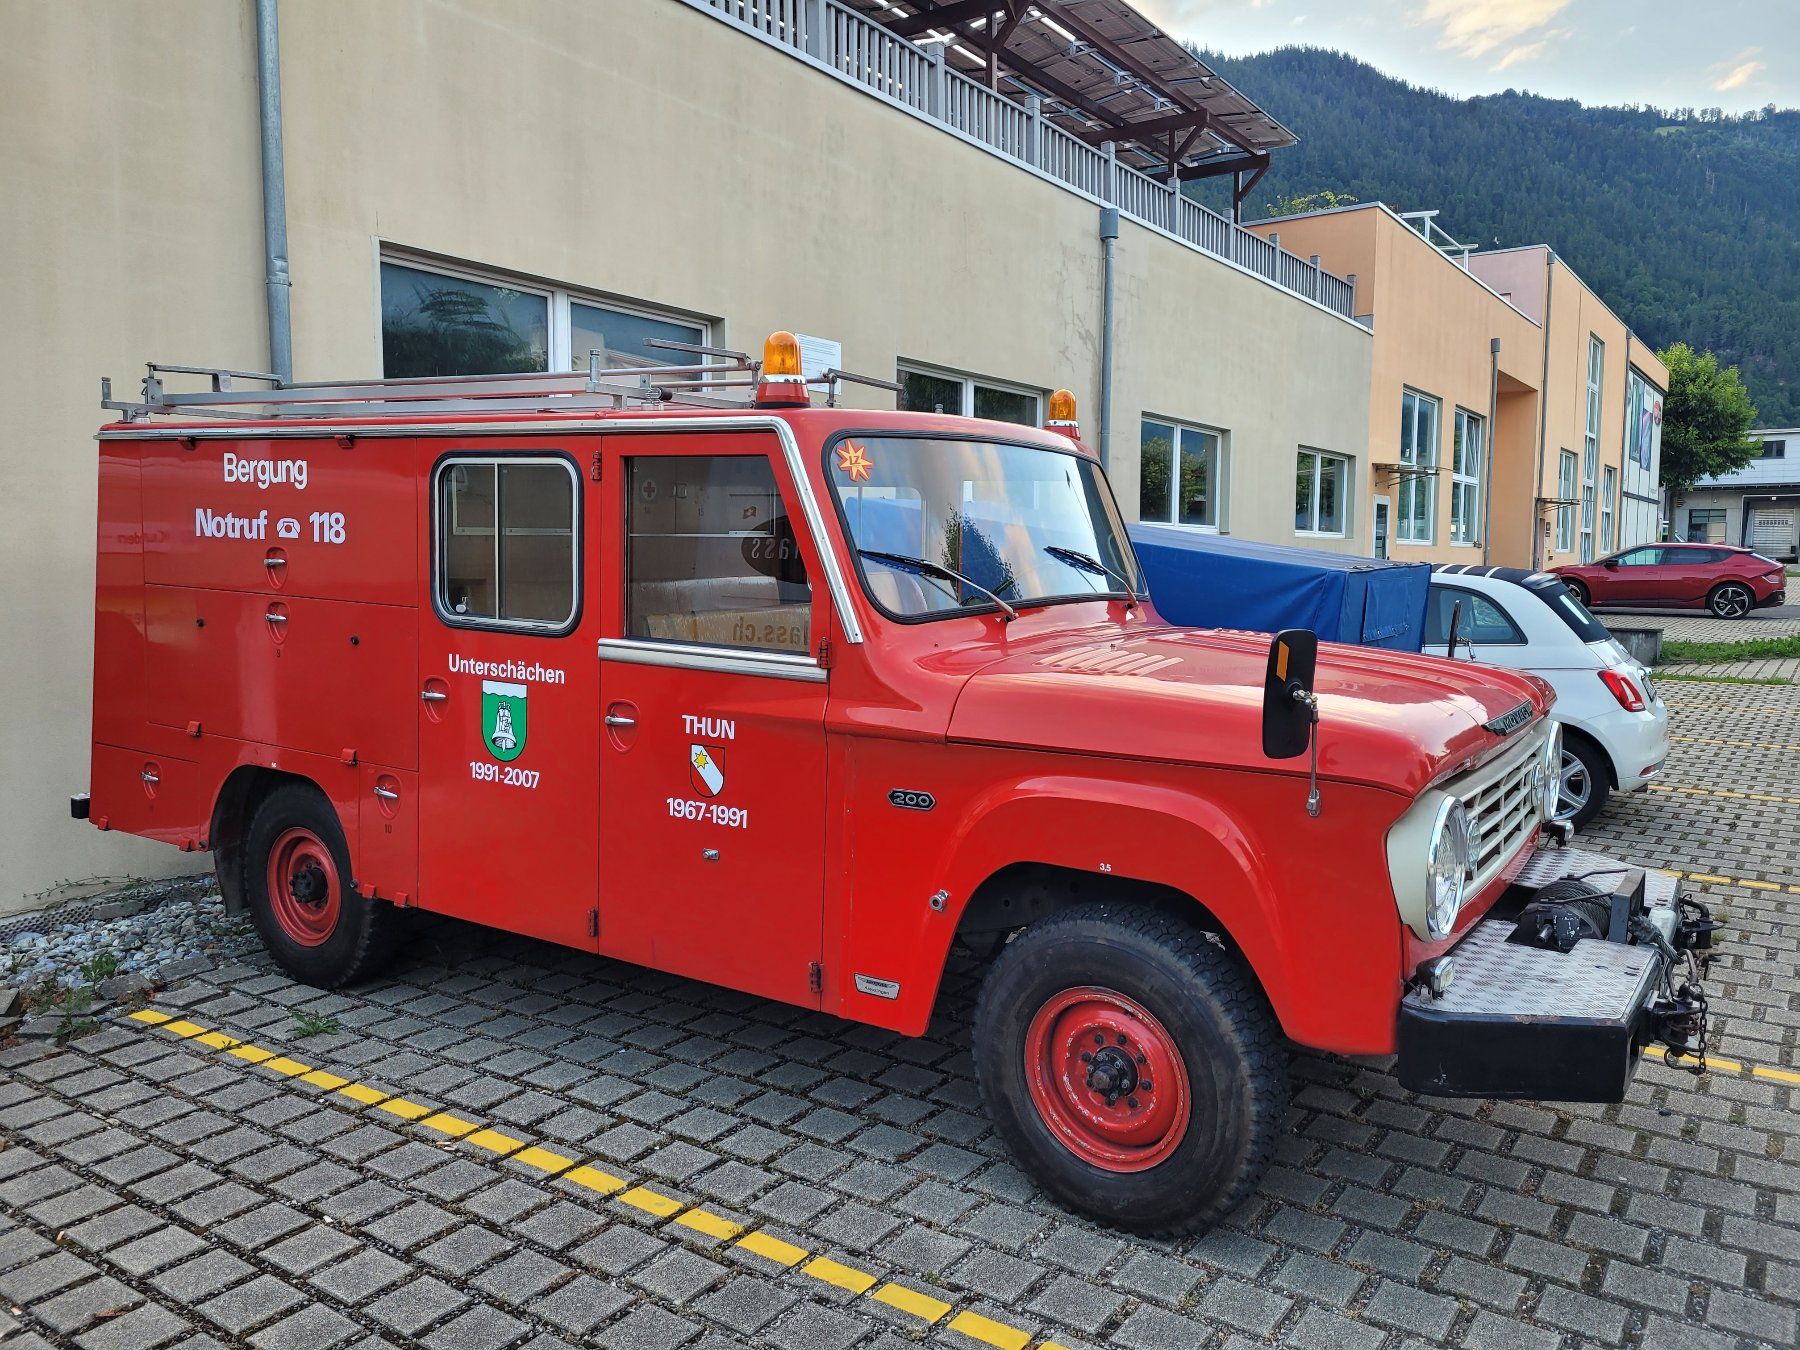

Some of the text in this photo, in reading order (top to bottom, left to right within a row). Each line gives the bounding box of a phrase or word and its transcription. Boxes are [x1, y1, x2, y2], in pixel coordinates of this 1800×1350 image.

[223, 452, 308, 490] Bergung
[195, 508, 346, 544] Notruf 118
[448, 653, 566, 685] Unterschächen
[681, 714, 735, 740] THUN
[469, 761, 540, 789] 1991-2007
[666, 797, 748, 829] 1967-1991
[893, 792, 930, 806] 200
